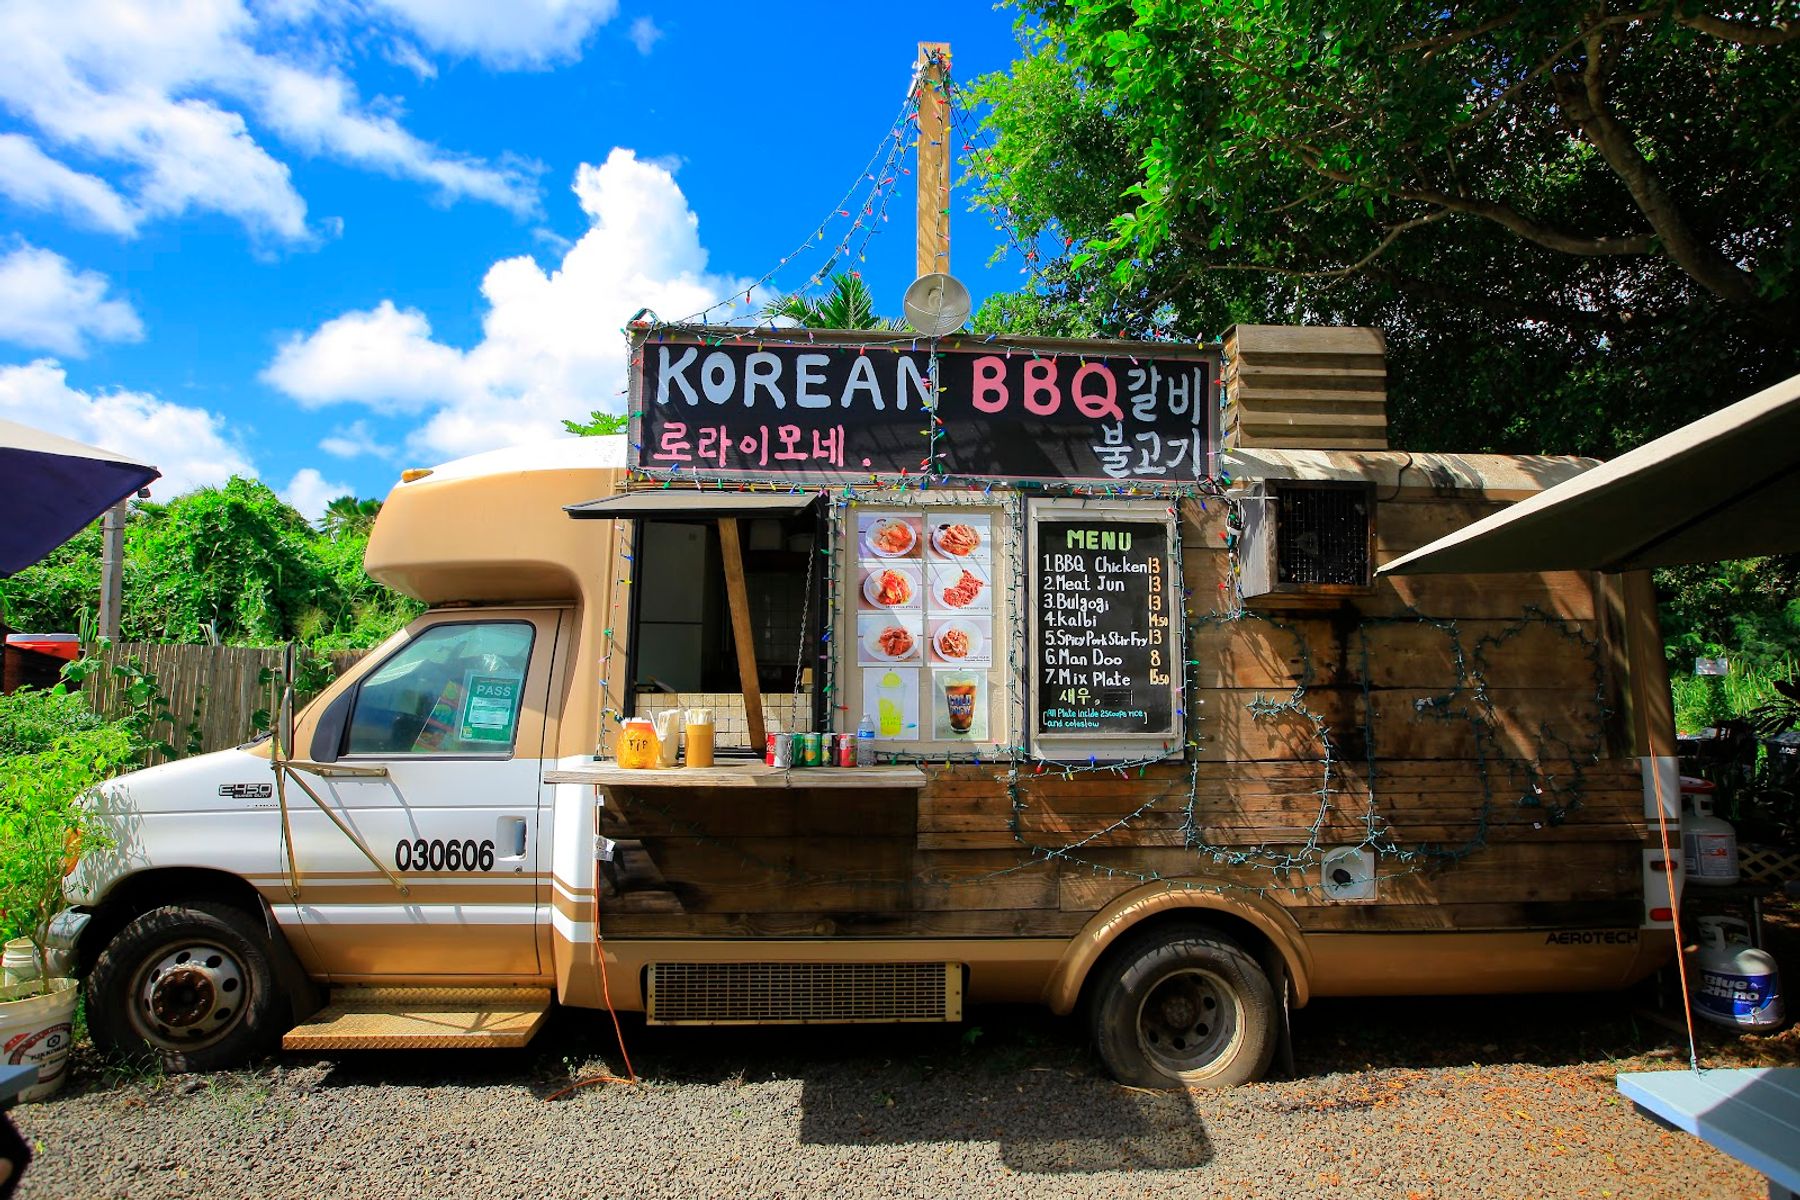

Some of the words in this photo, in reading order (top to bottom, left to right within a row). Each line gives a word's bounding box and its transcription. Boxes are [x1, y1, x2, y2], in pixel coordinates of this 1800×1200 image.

[656, 345, 940, 411] KOREAN
[972, 356, 1124, 422] BBQ
[1128, 365, 1201, 425] 갈비
[1093, 420, 1201, 479] 불고기
[1066, 529, 1132, 551] MENU
[1094, 555, 1147, 573] Chicken
[1148, 557, 1161, 574] 13
[1097, 575, 1125, 592] Jun
[1148, 576, 1162, 592] 13
[1148, 594, 1162, 611] 13
[1086, 630, 1107, 647] Pork
[1108, 631, 1130, 646] Stir
[1130, 631, 1148, 647] Fry
[1148, 629, 1162, 645] 13
[1092, 648, 1123, 666] Doo
[1150, 649, 1161, 667] 8
[1093, 671, 1131, 687] Plate
[476, 684, 512, 697] PASS
[1057, 708, 1077, 718] Plate
[1047, 719, 1063, 728] and
[395, 839, 495, 872] 030606
[1545, 931, 1639, 945] AEROTECH
[1703, 974, 1749, 990] Blue
